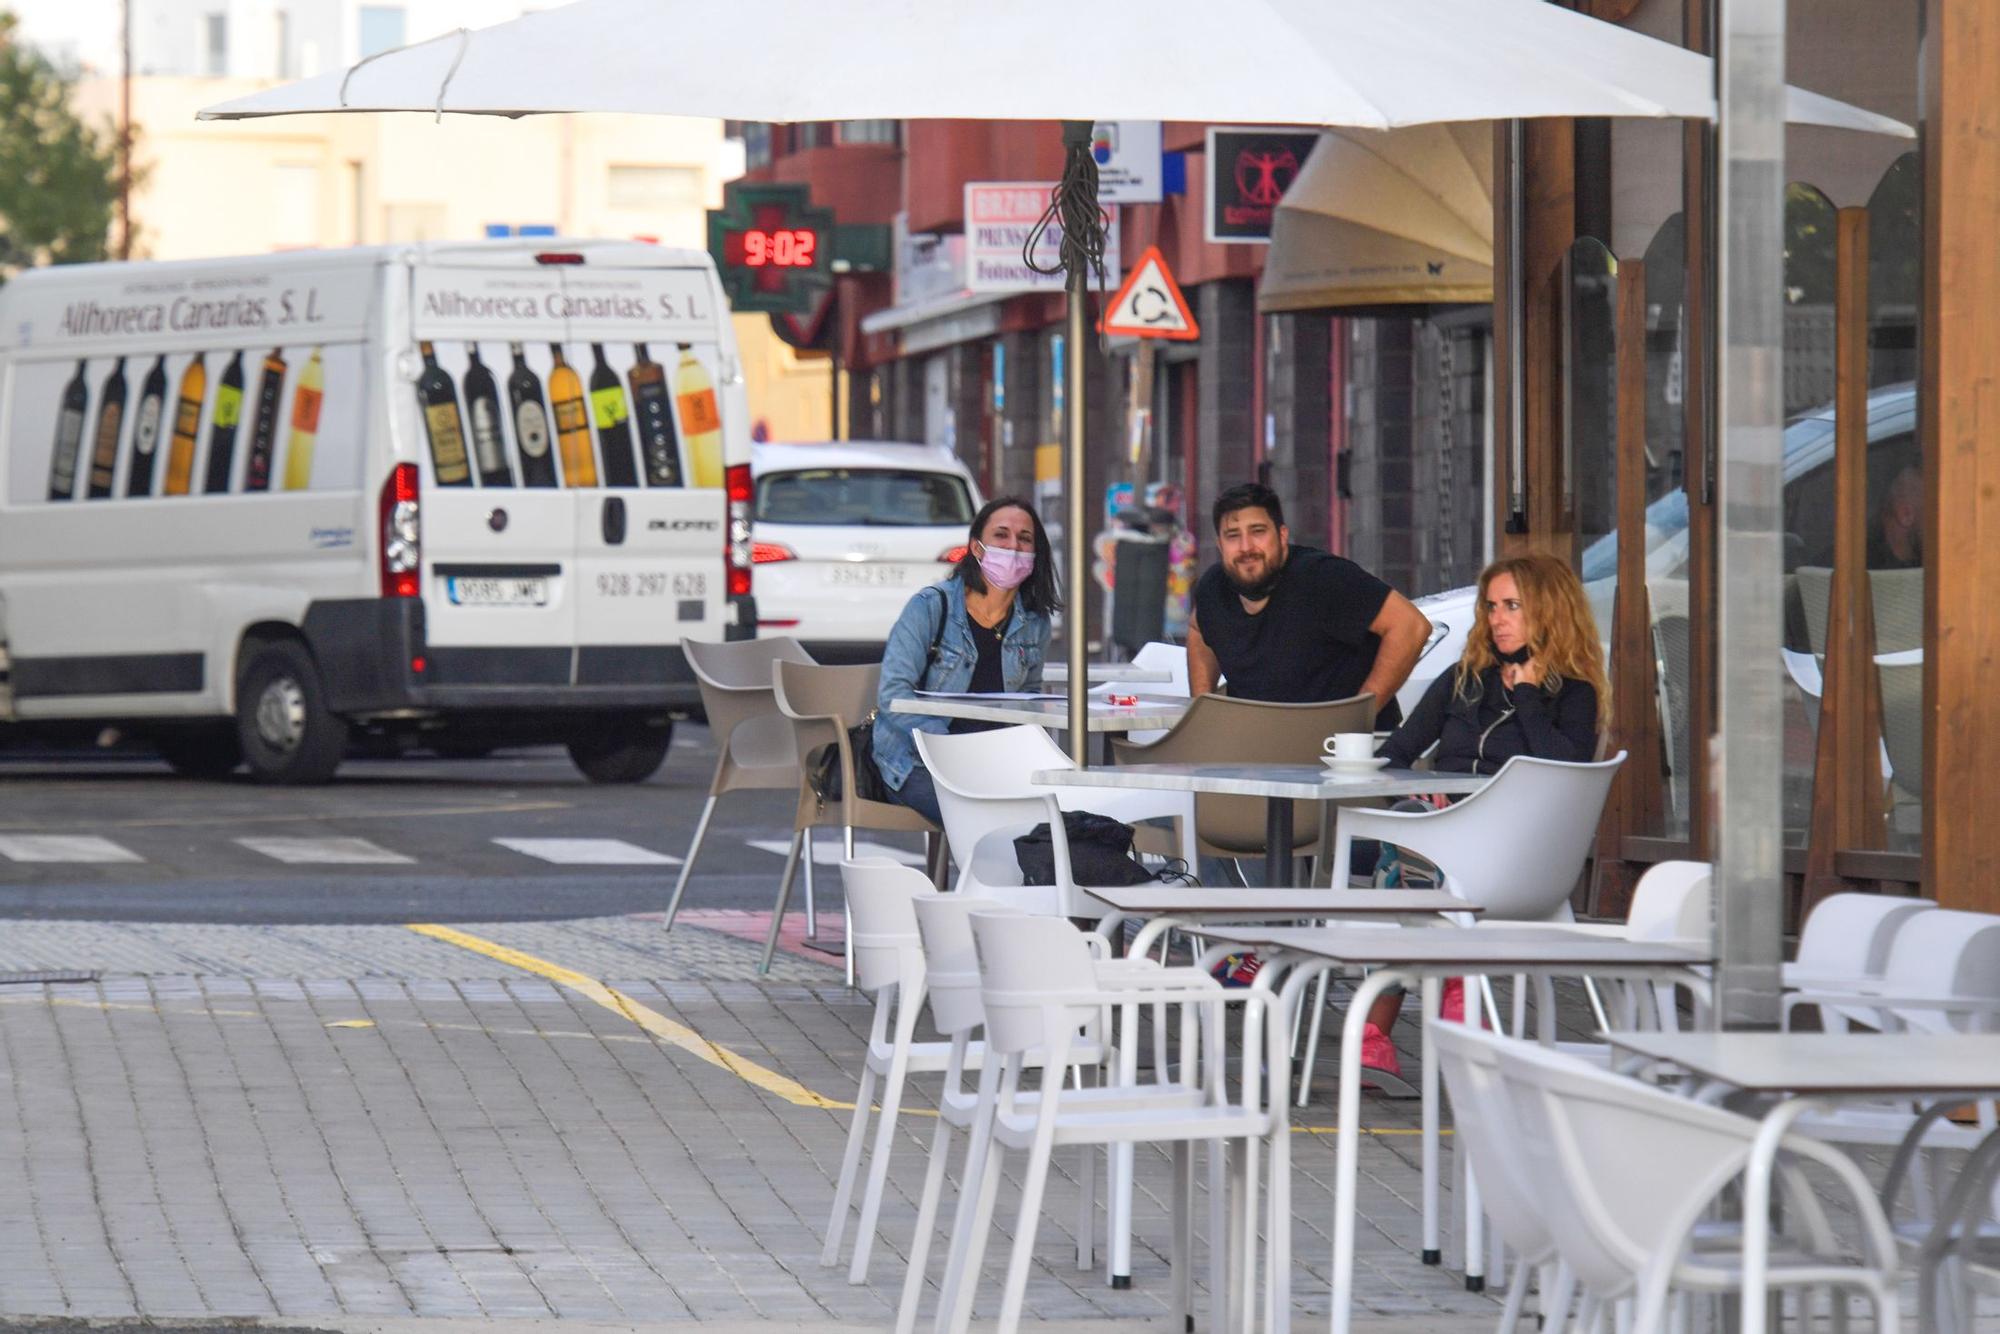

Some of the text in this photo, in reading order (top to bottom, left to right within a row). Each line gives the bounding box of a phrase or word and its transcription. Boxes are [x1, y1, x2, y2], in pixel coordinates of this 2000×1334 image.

[744, 230, 815, 266] 9:02
[57, 298, 164, 337] Alihoreca
[168, 293, 271, 331] Canarias,
[423, 290, 708, 321] Alihoreca Canarias, S. L.
[596, 572, 707, 596] 928 297 628
